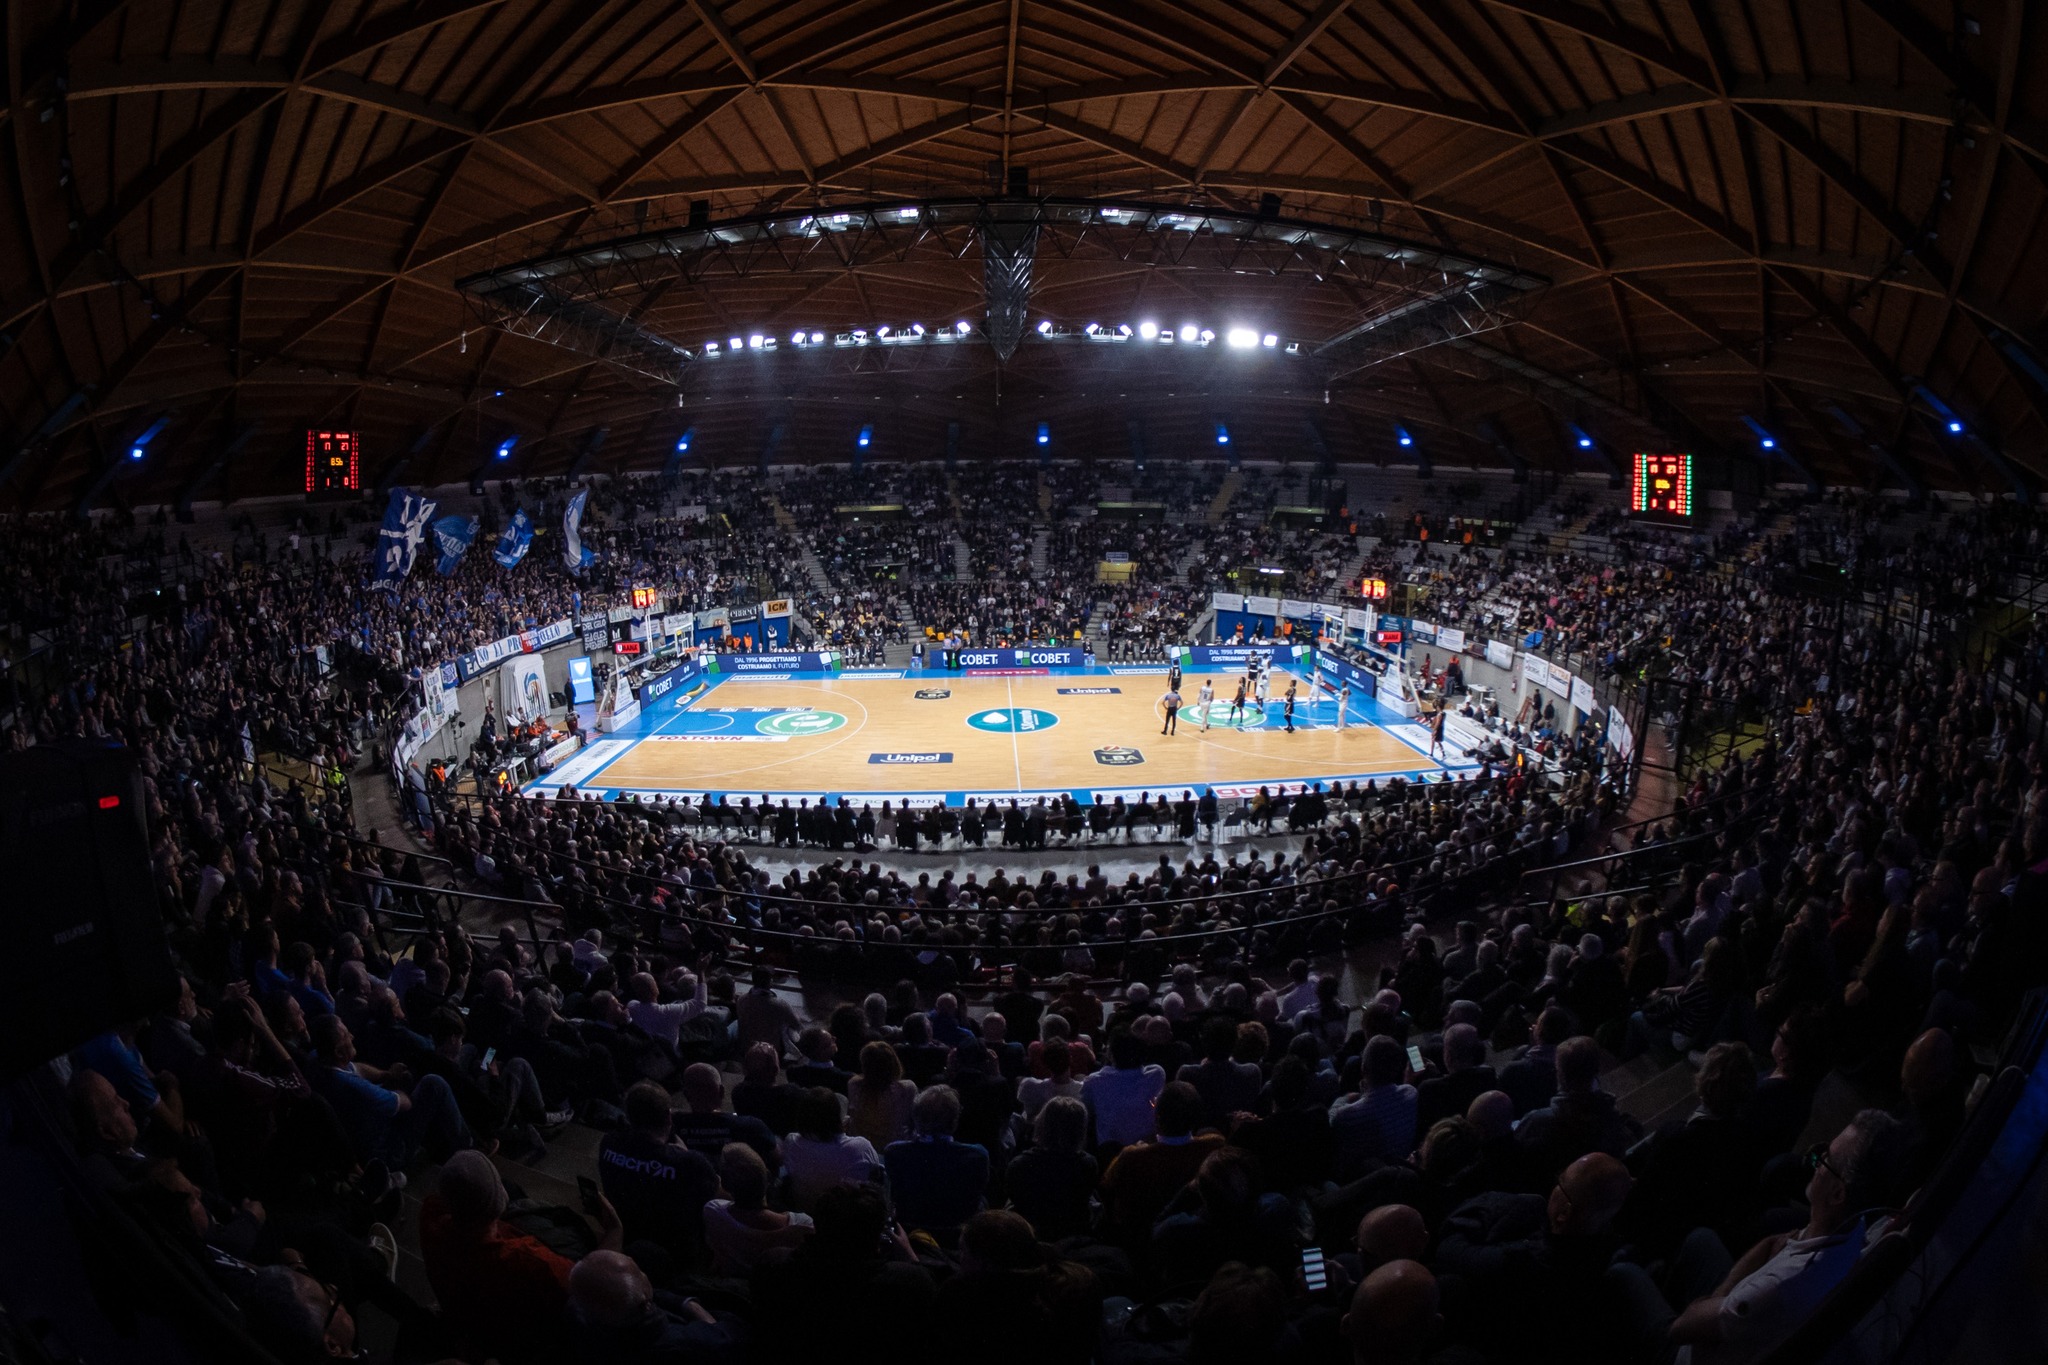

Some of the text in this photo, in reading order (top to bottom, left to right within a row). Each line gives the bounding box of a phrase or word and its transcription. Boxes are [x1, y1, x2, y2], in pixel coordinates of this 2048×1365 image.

[768, 602, 787, 613] ICM
[960, 654, 995, 665] COBET
[1031, 653, 1067, 664] COBET
[1322, 657, 1339, 674] COBET
[655, 677, 673, 696] COBET
[884, 753, 941, 763] Unipol
